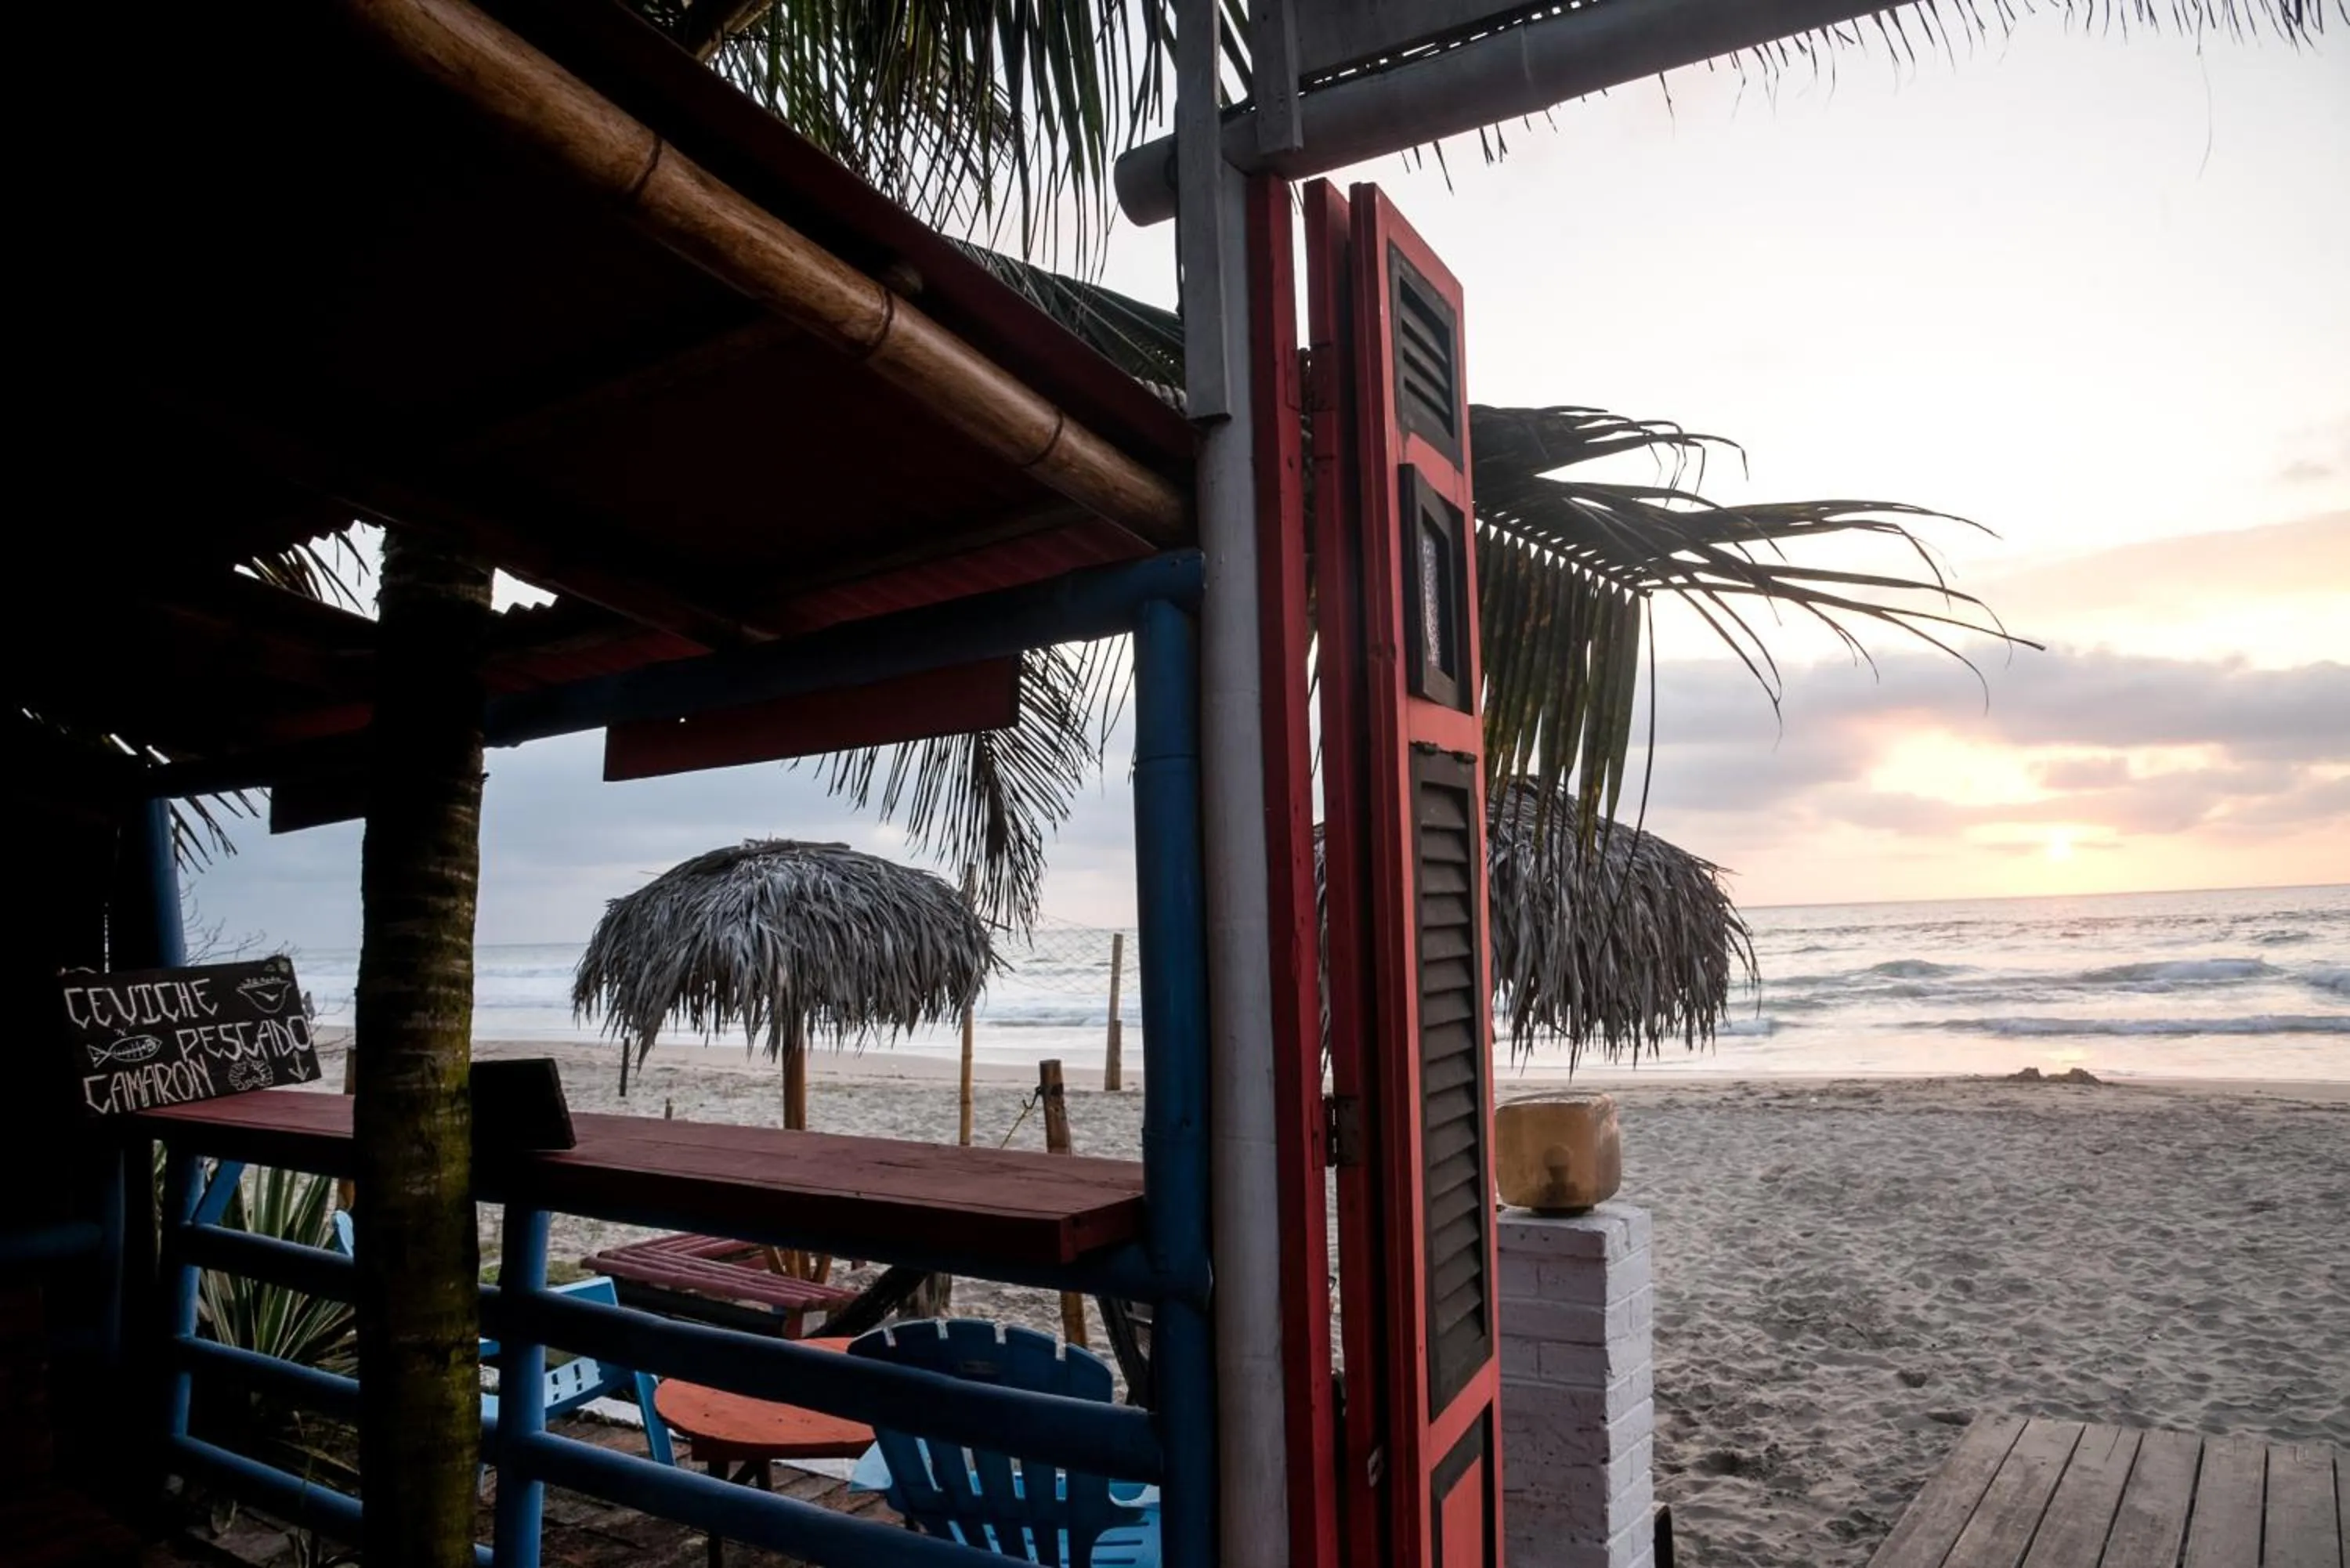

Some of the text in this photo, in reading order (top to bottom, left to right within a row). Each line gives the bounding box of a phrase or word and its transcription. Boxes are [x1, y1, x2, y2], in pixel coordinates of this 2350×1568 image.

[63, 978, 219, 1029] CEVICHE
[175, 1015, 313, 1061] PESCADO
[82, 1053, 217, 1115] CAMARON
